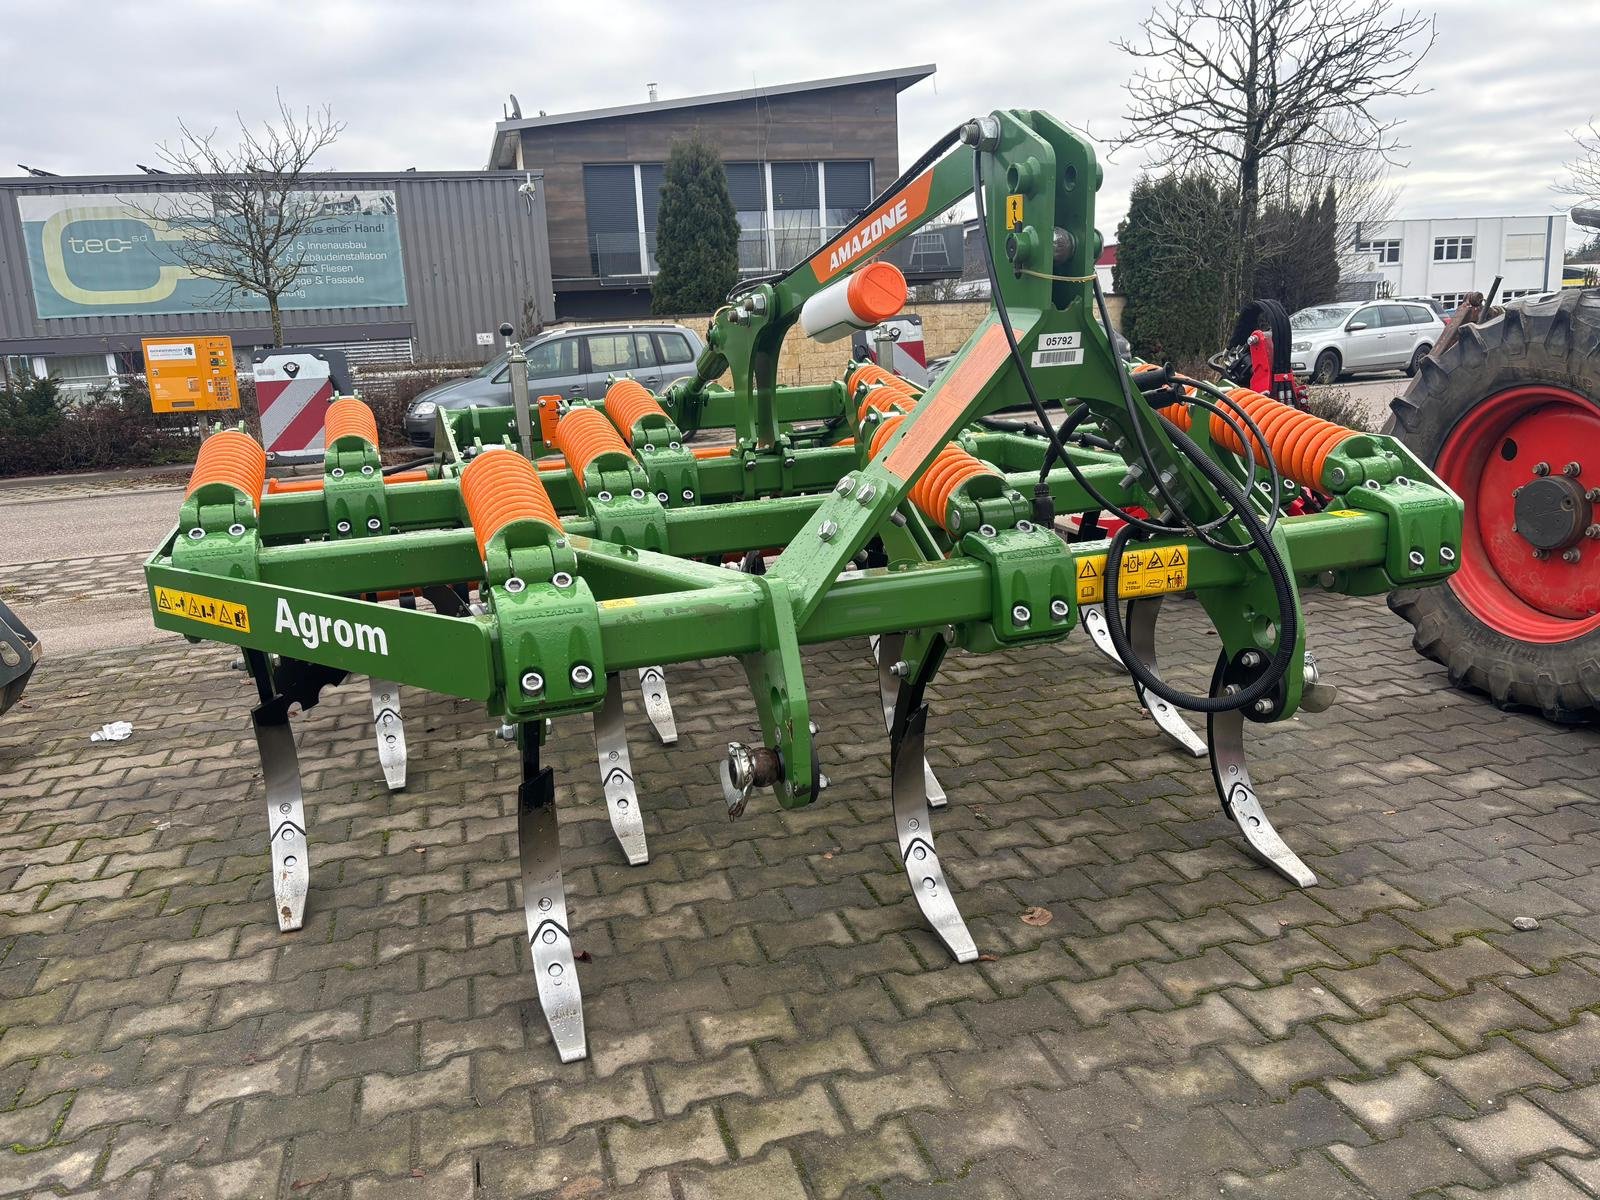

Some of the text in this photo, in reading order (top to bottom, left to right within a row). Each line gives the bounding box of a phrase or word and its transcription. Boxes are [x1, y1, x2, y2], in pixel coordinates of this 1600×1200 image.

[326, 224, 352, 233] einer
[354, 223, 385, 233] Hand!
[829, 198, 908, 272] AMAZONE
[307, 240, 367, 250] Innenausbau
[321, 263, 354, 273] Fliesen
[325, 275, 365, 285] Fassade
[1046, 335, 1073, 346] 05792
[275, 597, 389, 656] Agrom
